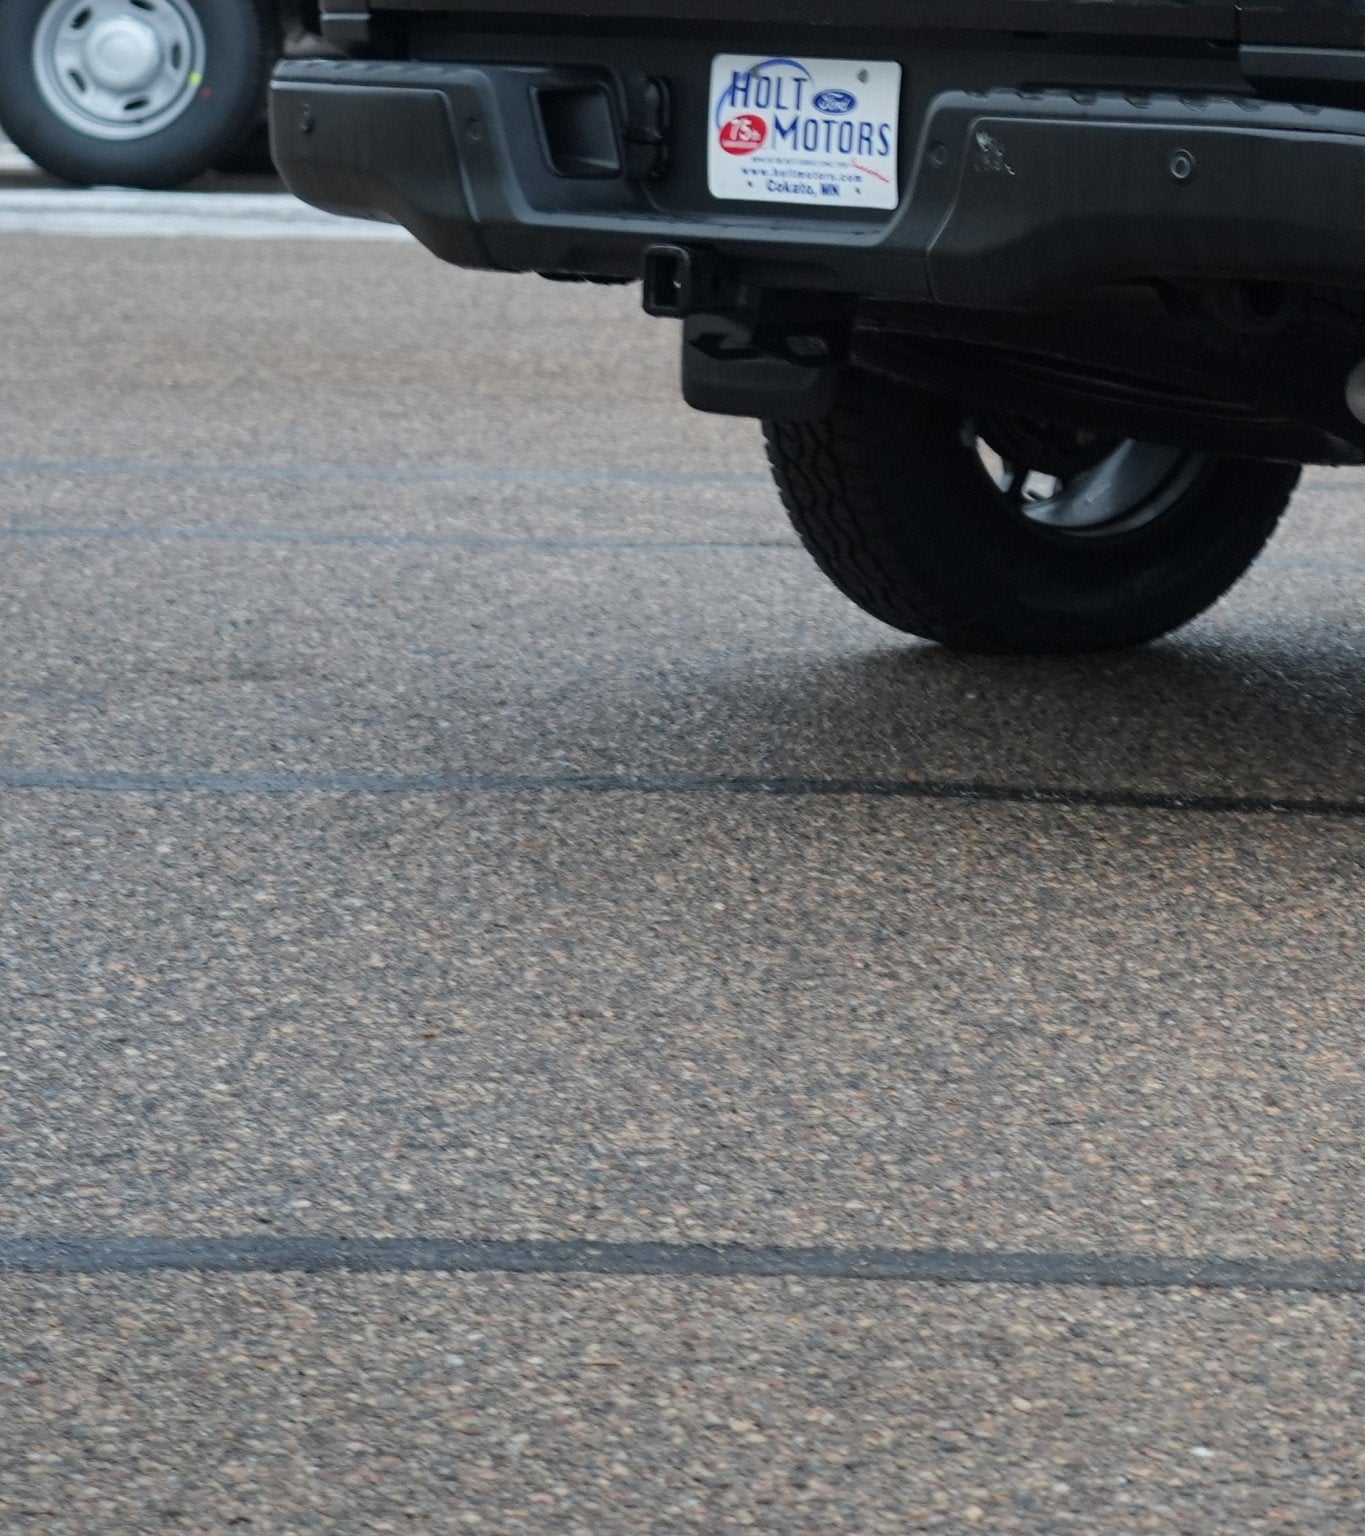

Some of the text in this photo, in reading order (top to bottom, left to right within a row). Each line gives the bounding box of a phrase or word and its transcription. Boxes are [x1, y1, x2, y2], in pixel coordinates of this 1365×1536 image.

[730, 70, 808, 111] HOLT
[772, 114, 892, 157] MOTORS
[741, 167, 864, 183] www.holtmotors.com
[820, 183, 841, 197] MN
